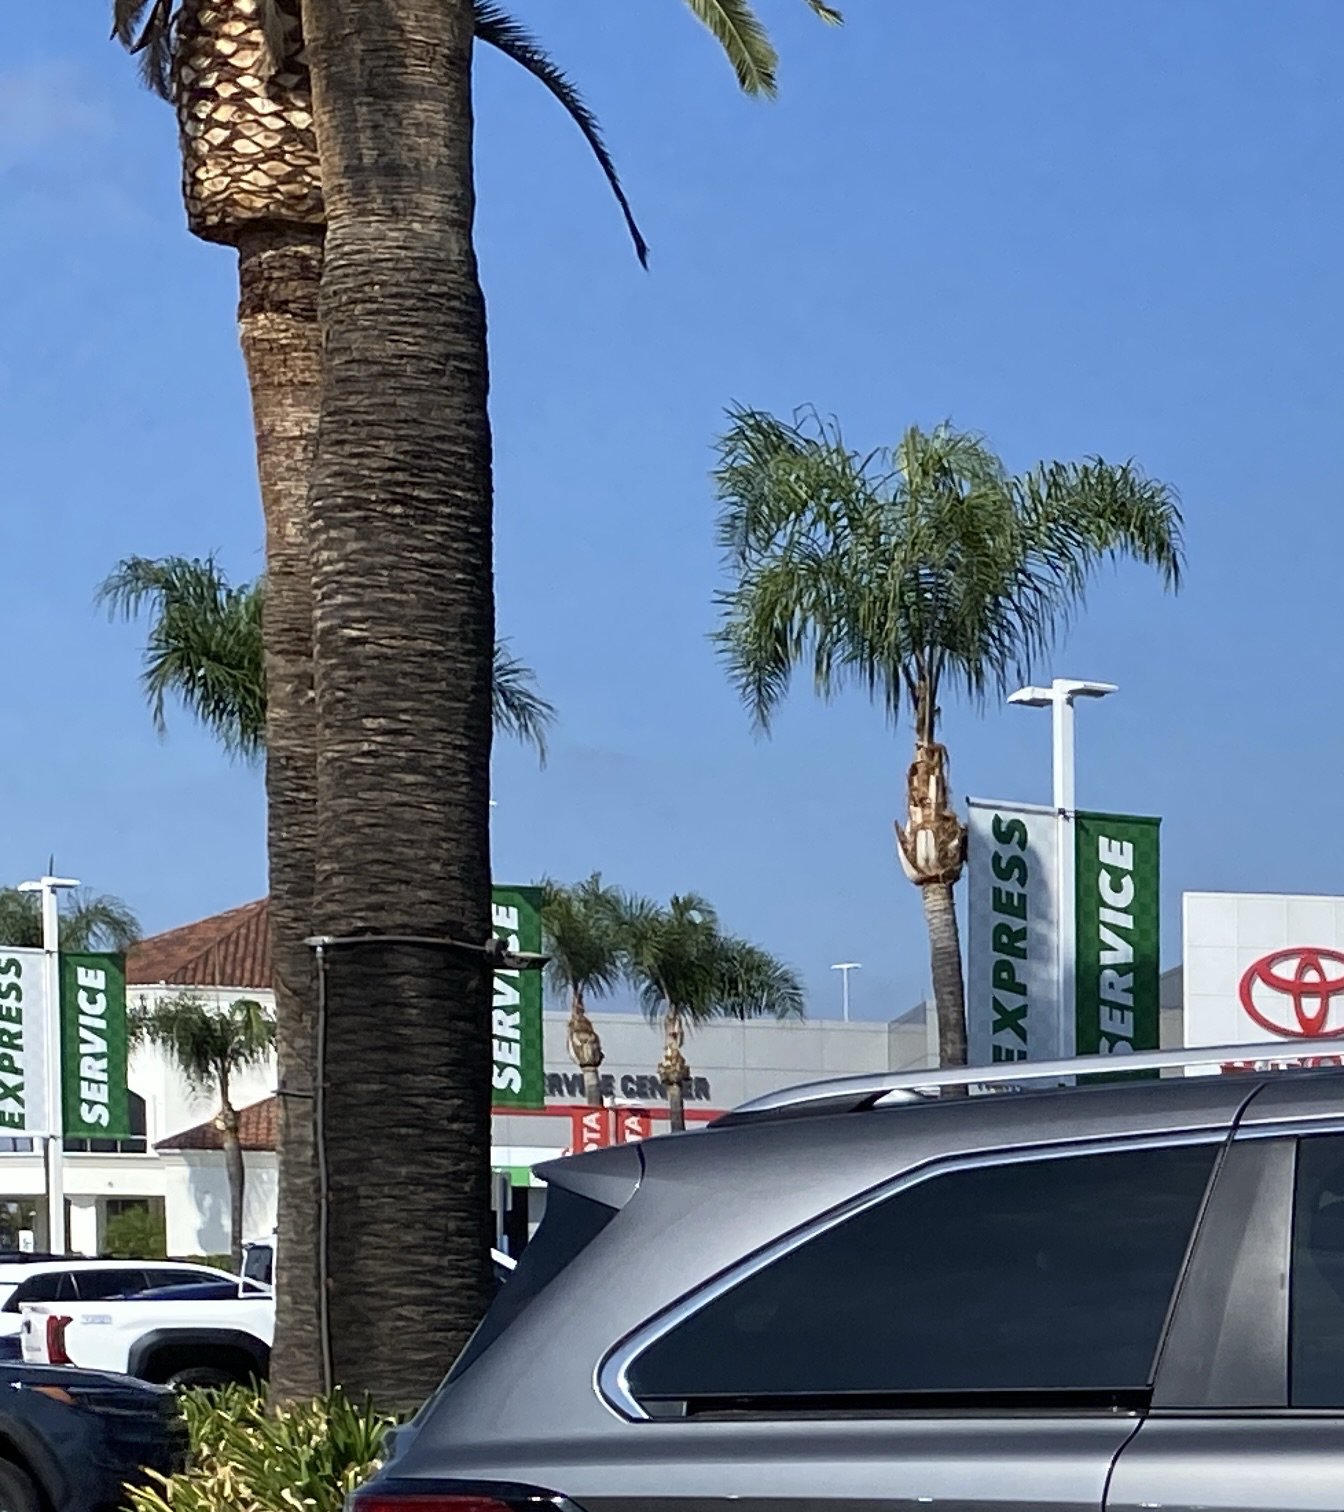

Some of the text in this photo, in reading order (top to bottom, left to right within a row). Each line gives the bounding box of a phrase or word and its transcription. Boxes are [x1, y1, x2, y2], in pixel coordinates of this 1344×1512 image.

[991, 813, 1028, 1062] EXPRESS
[0, 957, 26, 1131] EXPRESS
[76, 965, 110, 1128] SERVICE
[621, 1074, 711, 1101] CENER
